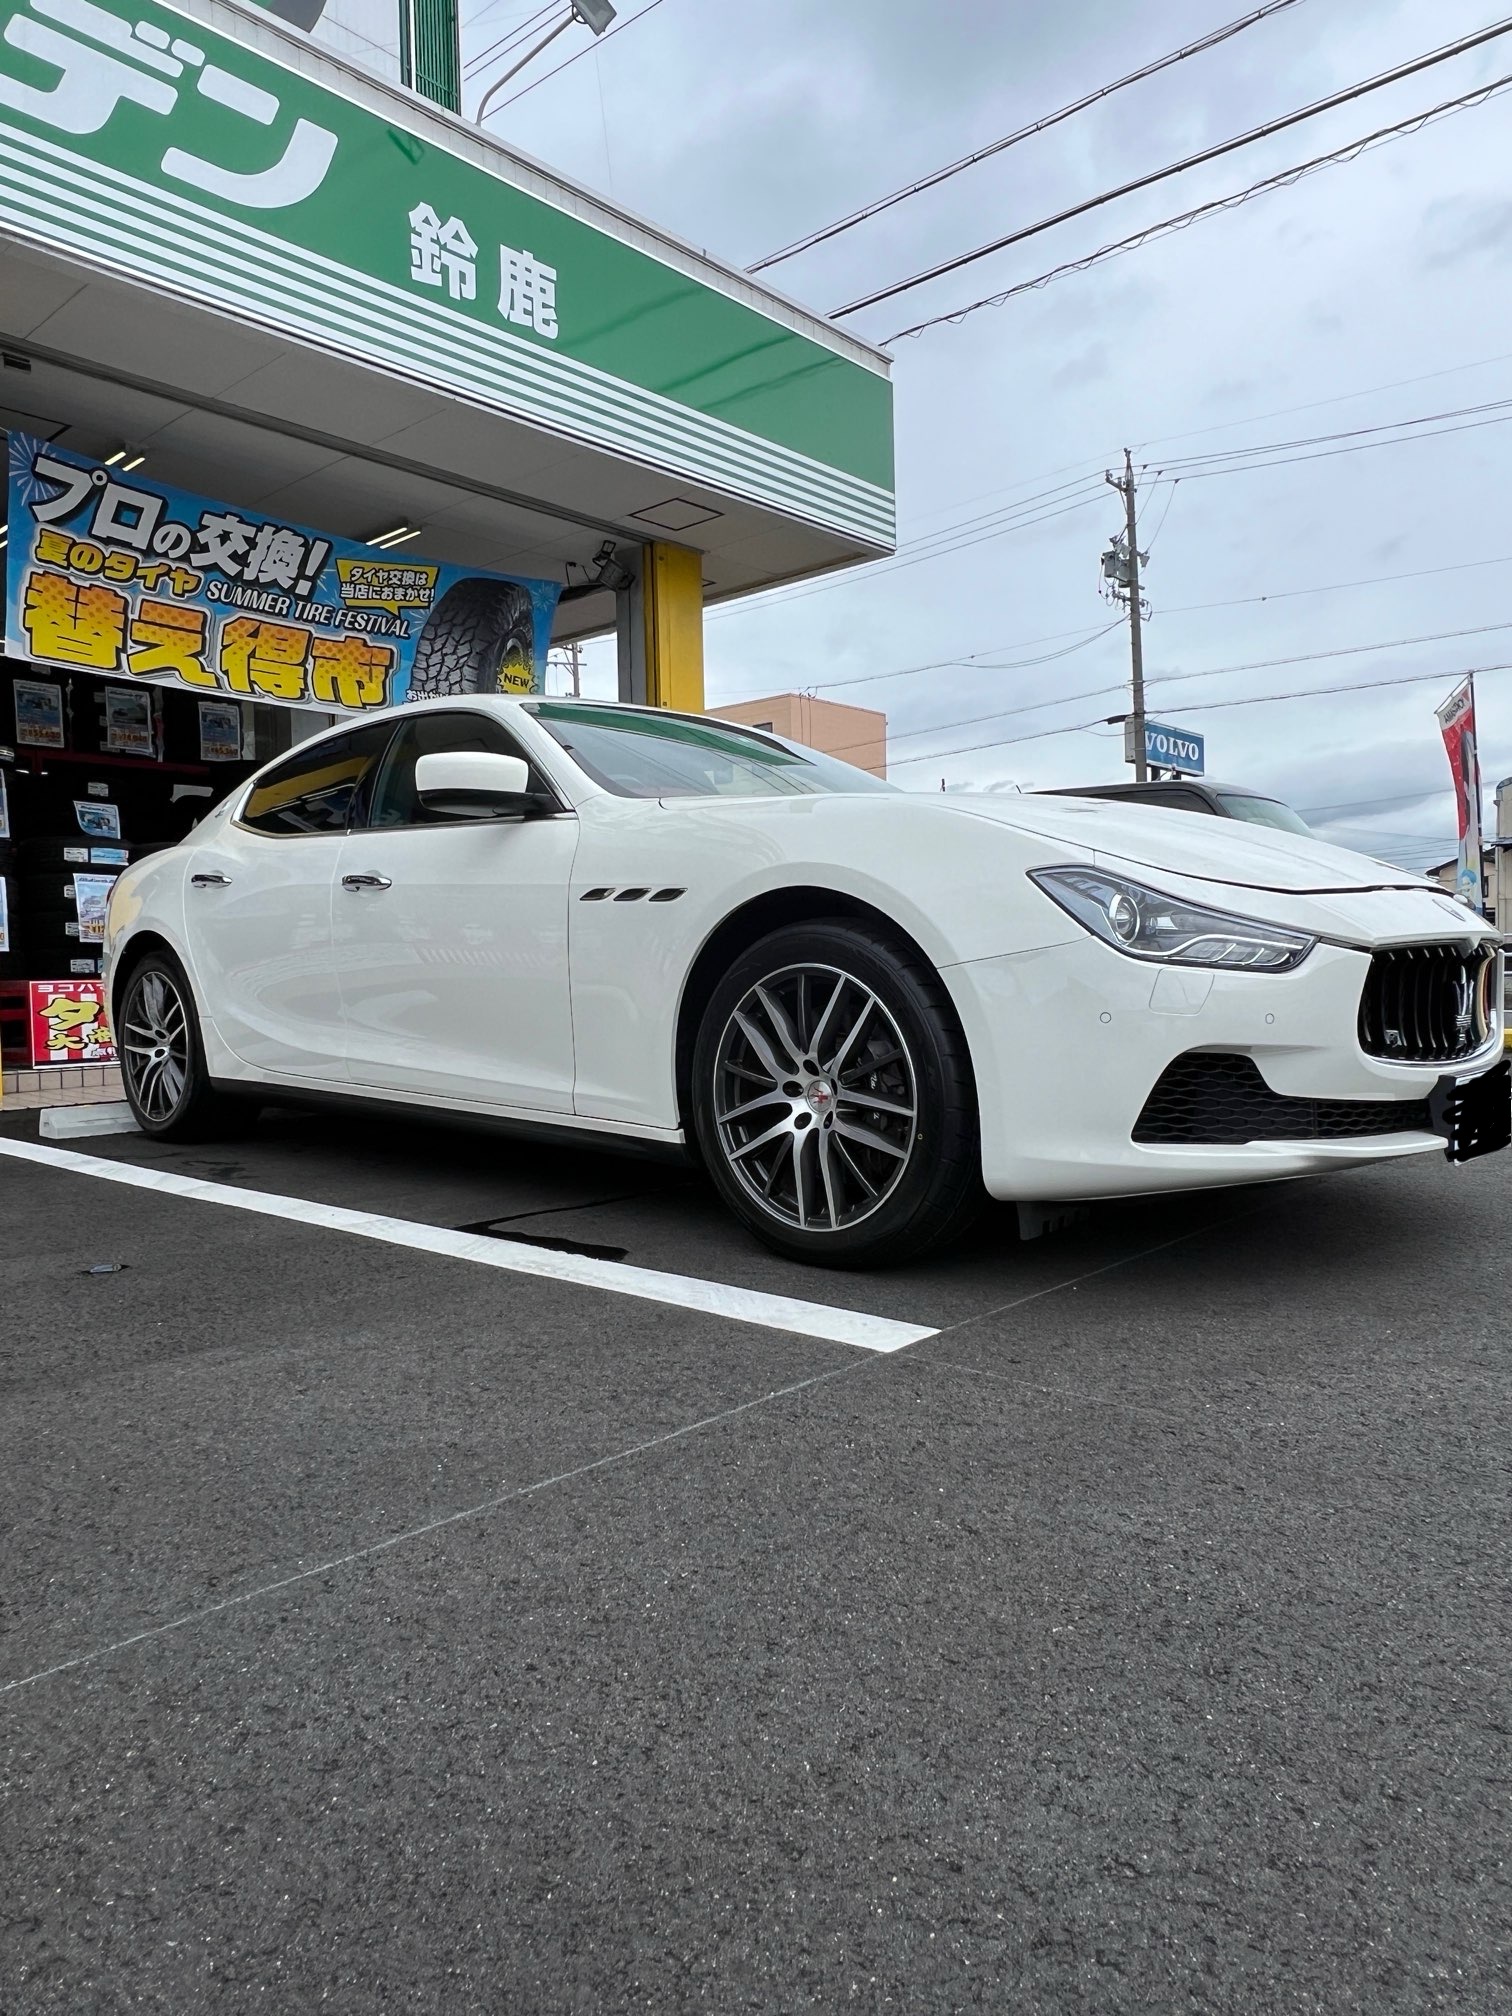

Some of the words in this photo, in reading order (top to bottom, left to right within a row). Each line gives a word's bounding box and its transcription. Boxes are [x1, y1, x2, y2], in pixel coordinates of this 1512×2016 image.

[408, 202, 559, 340] 鈴鹿
[32, 456, 330, 596] プロの交換!
[35, 529, 200, 595] 夏のタイヤ
[350, 567, 428, 586] タイヤ交換は
[206, 580, 290, 616] SUMMER
[294, 600, 333, 625] TIRE
[335, 610, 410, 638] FESTIVAL
[340, 582, 435, 602] 当店におまかせ!
[24, 571, 392, 709] 替え得市
[503, 673, 530, 689] NEW
[1145, 731, 1199, 761] VOLVO
